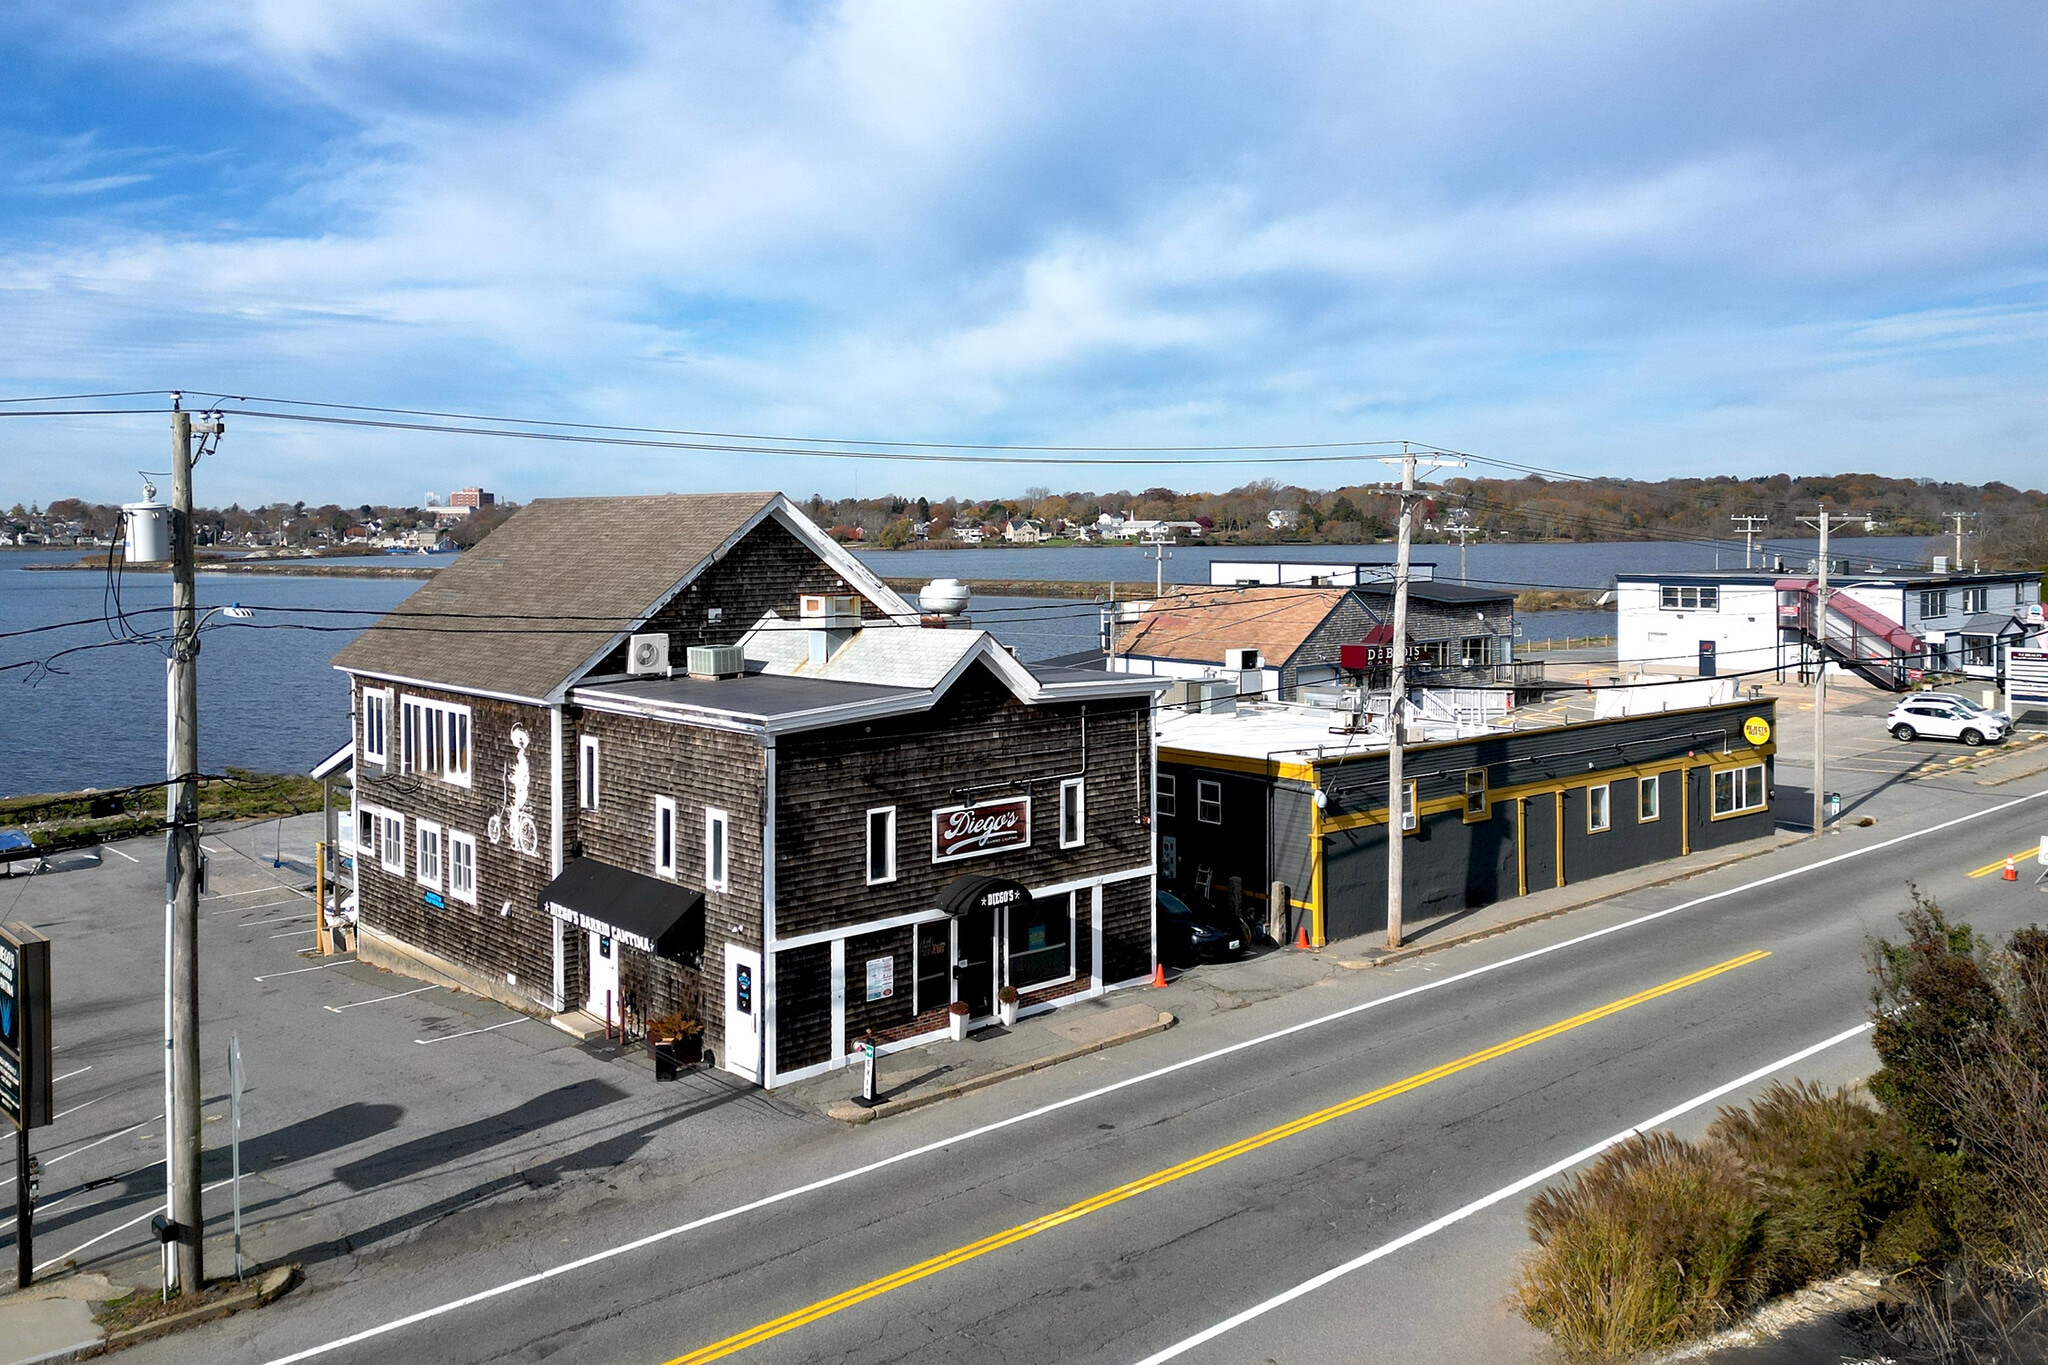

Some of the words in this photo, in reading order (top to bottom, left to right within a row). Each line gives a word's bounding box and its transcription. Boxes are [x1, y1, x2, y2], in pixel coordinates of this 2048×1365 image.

[944, 810, 1019, 847] Diego's
[987, 889, 1014, 906] DIEGO'S
[549, 901, 579, 926] DIEGO'S
[580, 913, 610, 938] BARRIO
[611, 925, 651, 953] CANTINA
